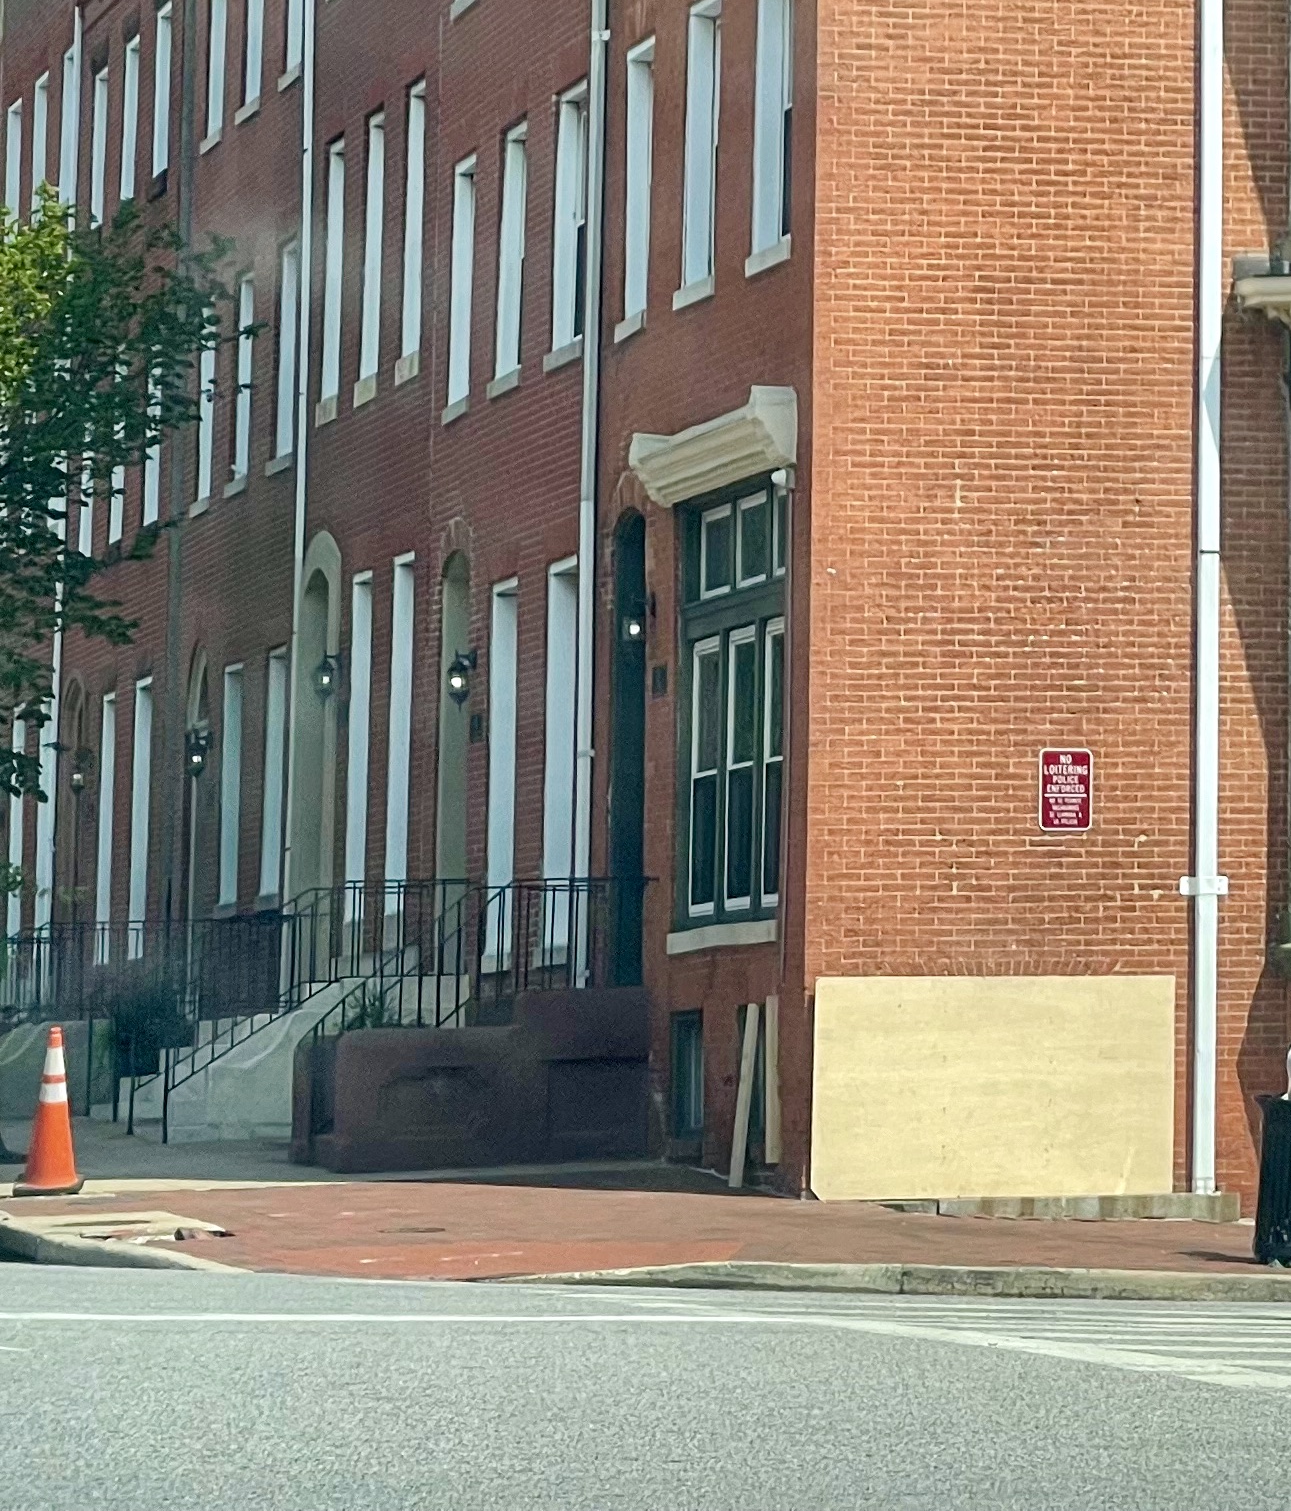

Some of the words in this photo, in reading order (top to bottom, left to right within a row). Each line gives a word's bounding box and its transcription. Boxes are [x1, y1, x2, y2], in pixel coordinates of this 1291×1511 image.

[1059, 754, 1072, 764] NO
[1043, 764, 1088, 775] LOITERING
[1052, 775, 1079, 784] POLICE
[1046, 784, 1086, 793] ENFORCED
